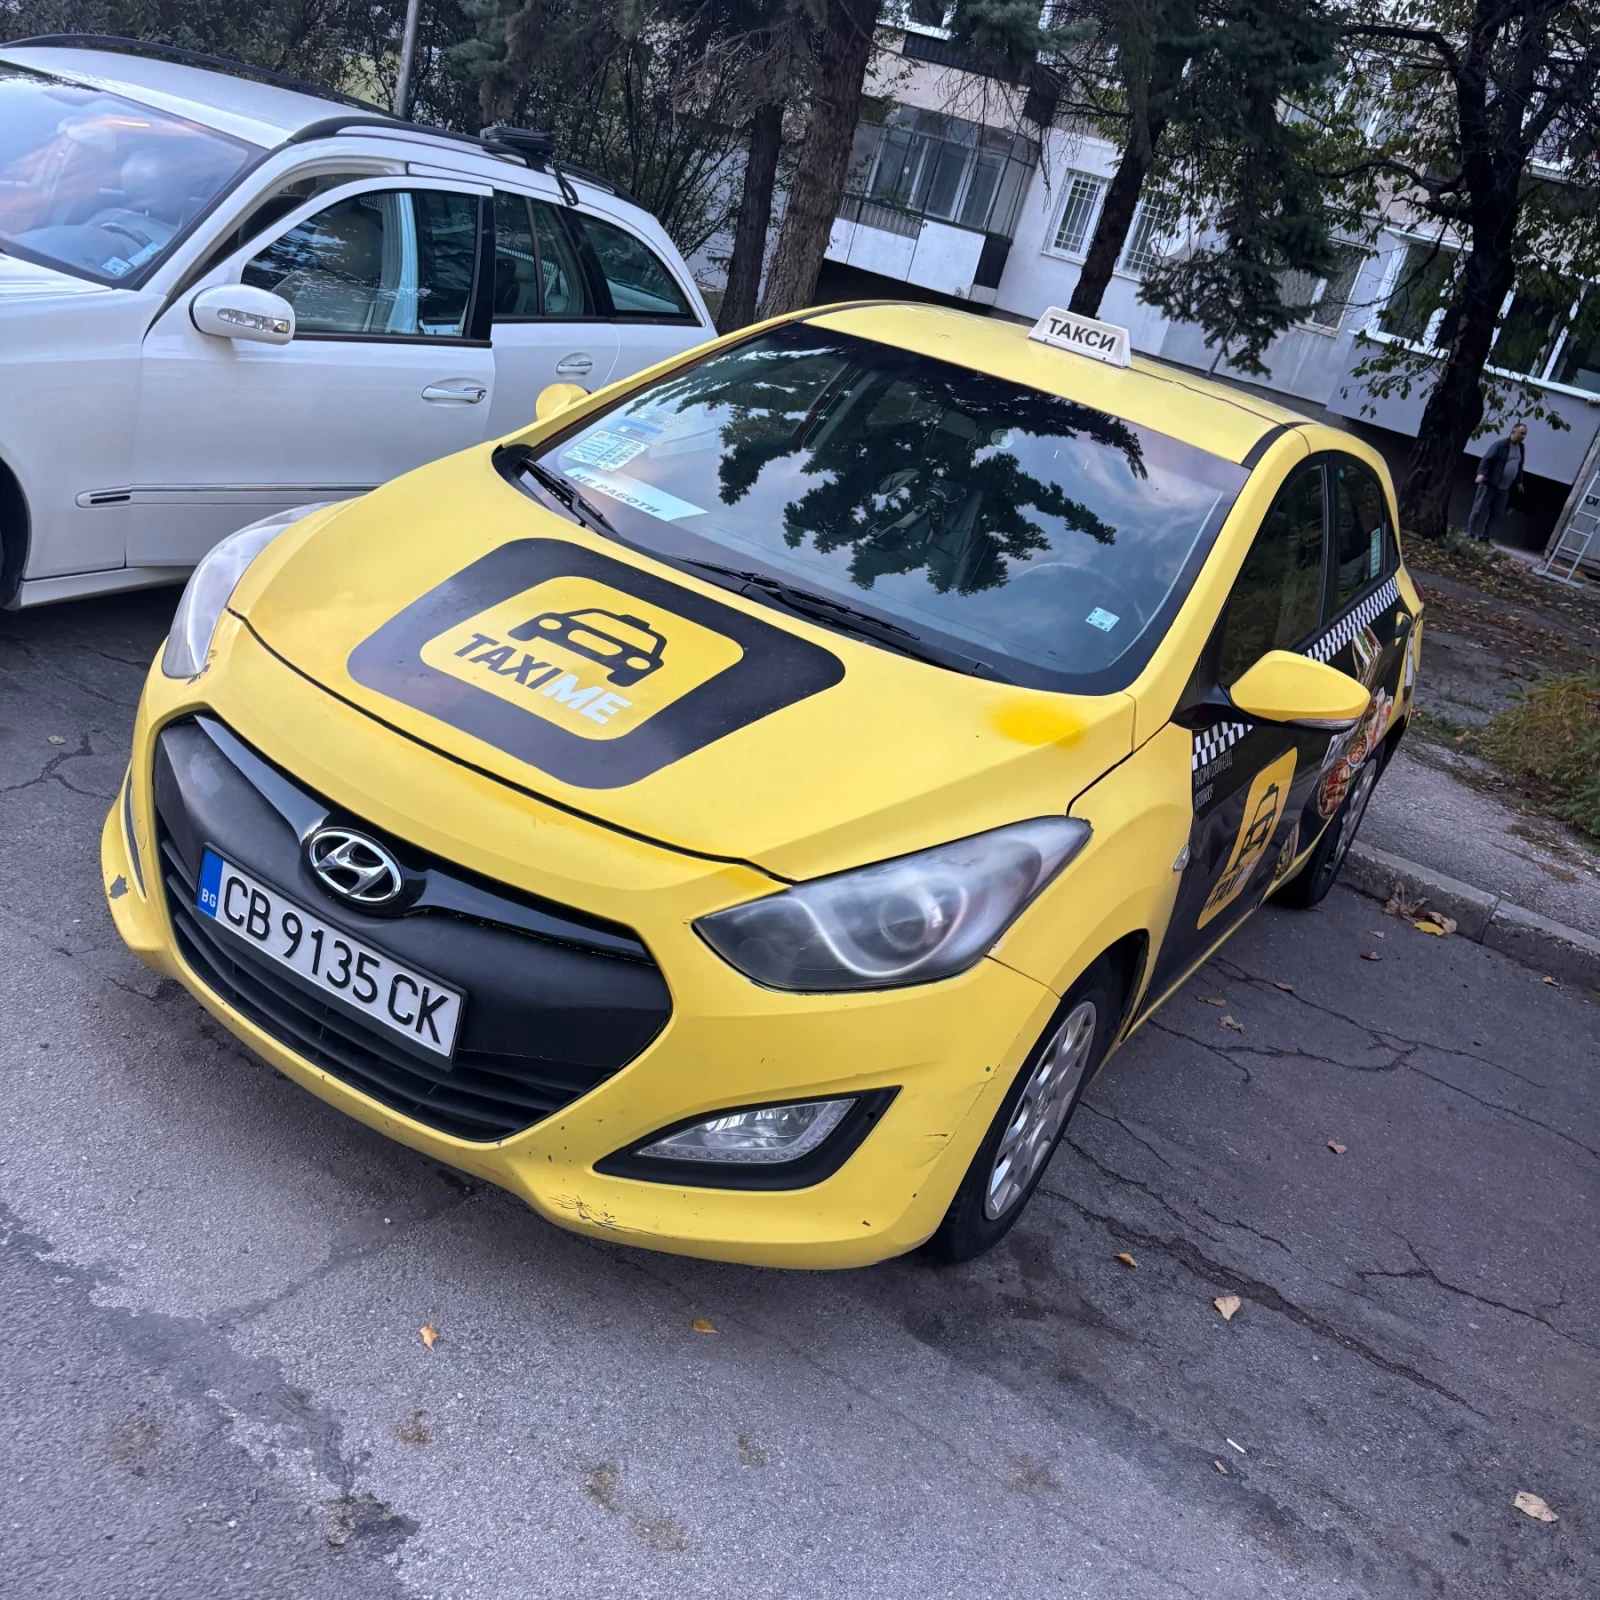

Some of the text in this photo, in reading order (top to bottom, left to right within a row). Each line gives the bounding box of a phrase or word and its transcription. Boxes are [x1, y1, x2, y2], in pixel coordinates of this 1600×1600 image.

[1049, 317, 1116, 352] ТАКСИ
[571, 473, 661, 513] НЕ РАБОТИ
[454, 633, 632, 724] TAXIME
[201, 888, 217, 907] BG
[223, 875, 449, 1045] CB 9135 CK
